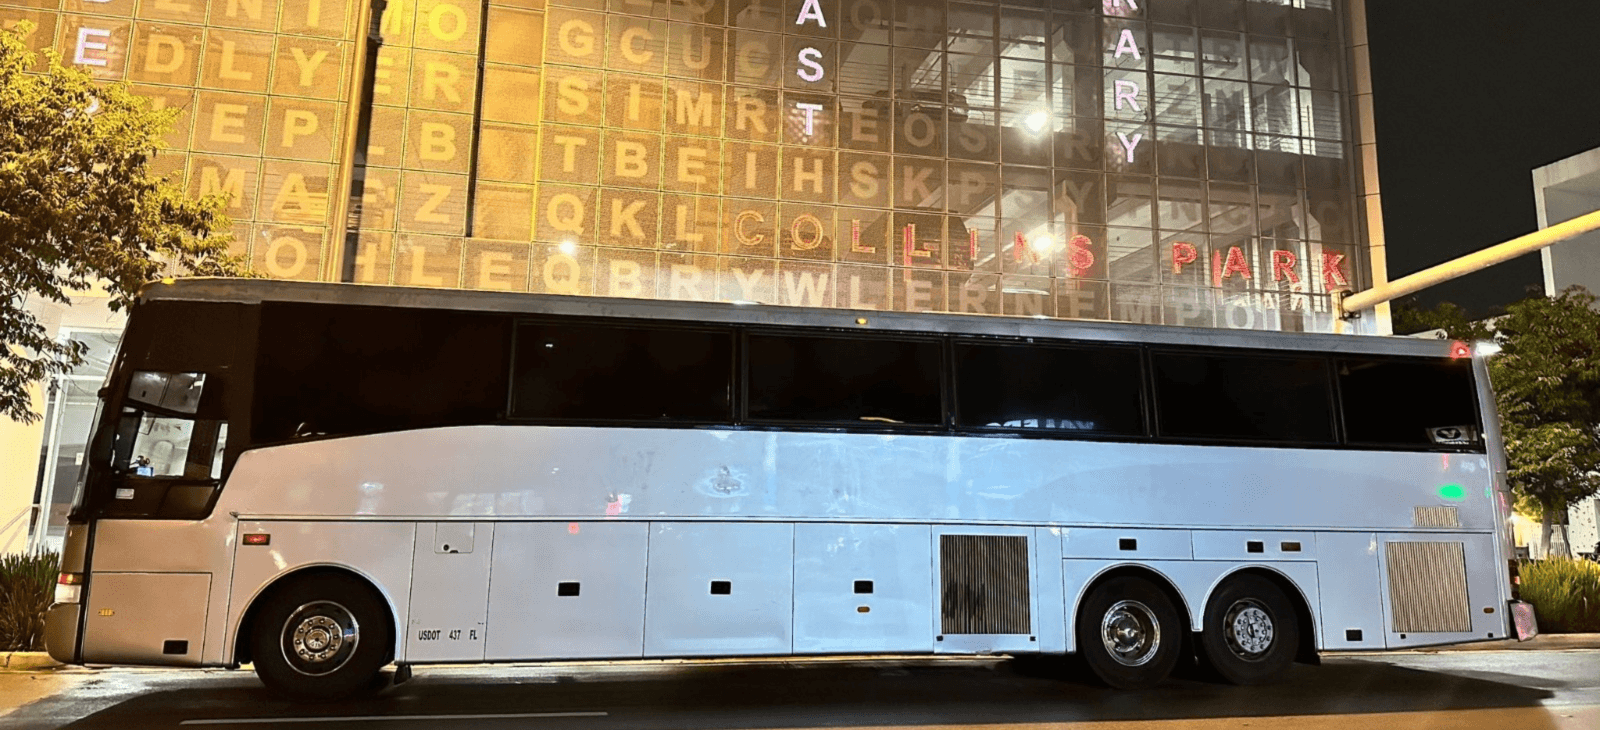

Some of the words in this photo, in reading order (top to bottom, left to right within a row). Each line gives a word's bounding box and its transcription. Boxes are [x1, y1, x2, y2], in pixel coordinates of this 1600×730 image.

[734, 210, 1095, 270] COLLINS
[1172, 240, 1348, 288] PARK
[418, 629, 441, 641] USDOT
[448, 629, 462, 641] 437
[469, 629, 478, 640] FL
